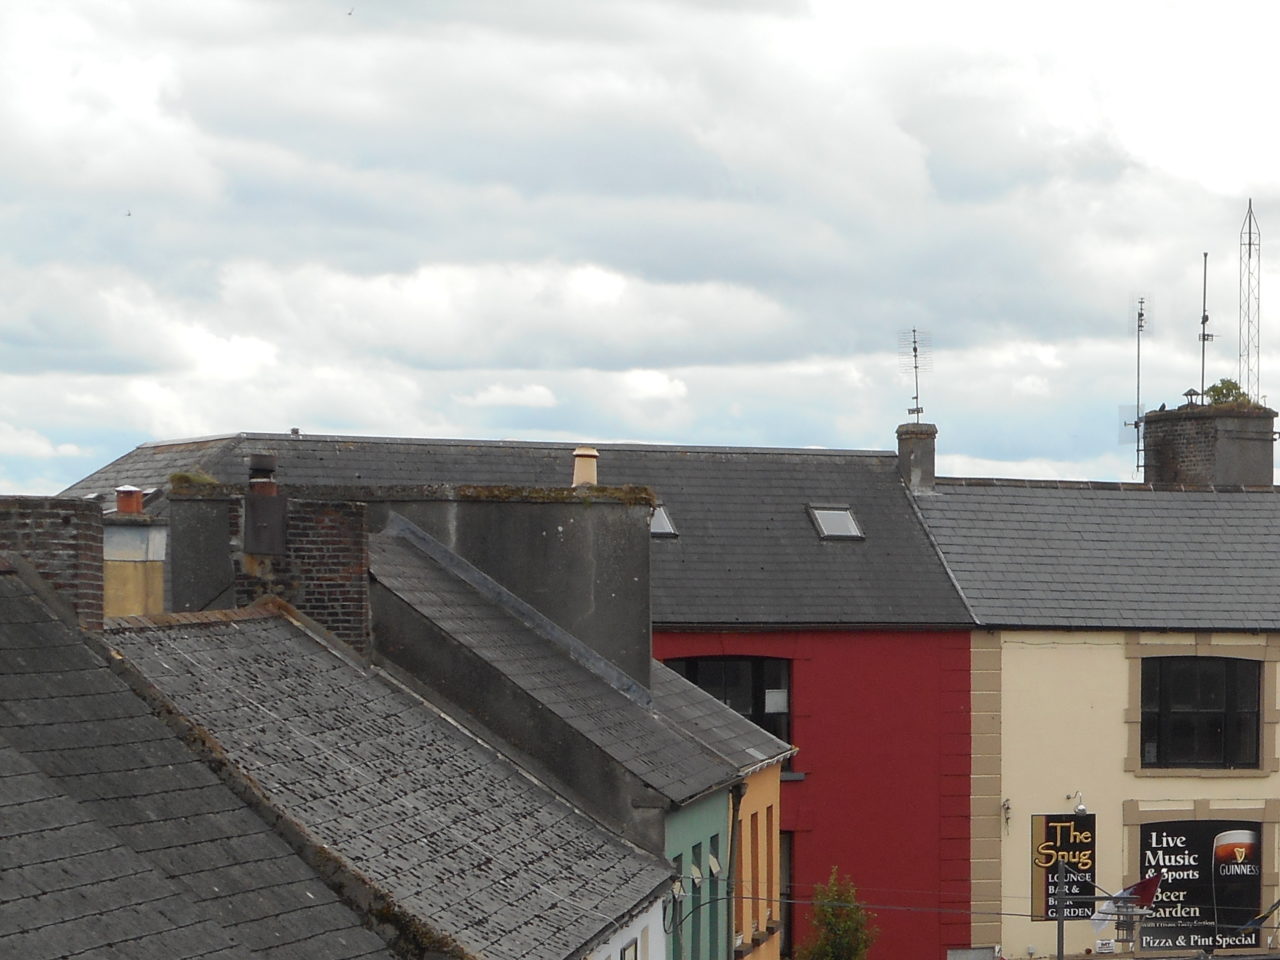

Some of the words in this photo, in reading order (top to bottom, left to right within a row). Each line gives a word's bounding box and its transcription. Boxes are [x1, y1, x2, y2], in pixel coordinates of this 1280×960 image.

[1049, 821, 1092, 847] The
[1150, 831, 1186, 848] Live
[1034, 841, 1092, 870] Snug
[1145, 850, 1199, 866] Music
[1145, 868, 1157, 879] &
[1220, 863, 1260, 876] GUINNESS
[1071, 885, 1080, 894] &
[1153, 888, 1187, 902] Beer
[1048, 908, 1092, 917] GRDEN
[1142, 936, 1173, 948] Pizza
[1176, 935, 1186, 946] &
[1190, 934, 1213, 946] Pint
[1215, 933, 1256, 948] Special
